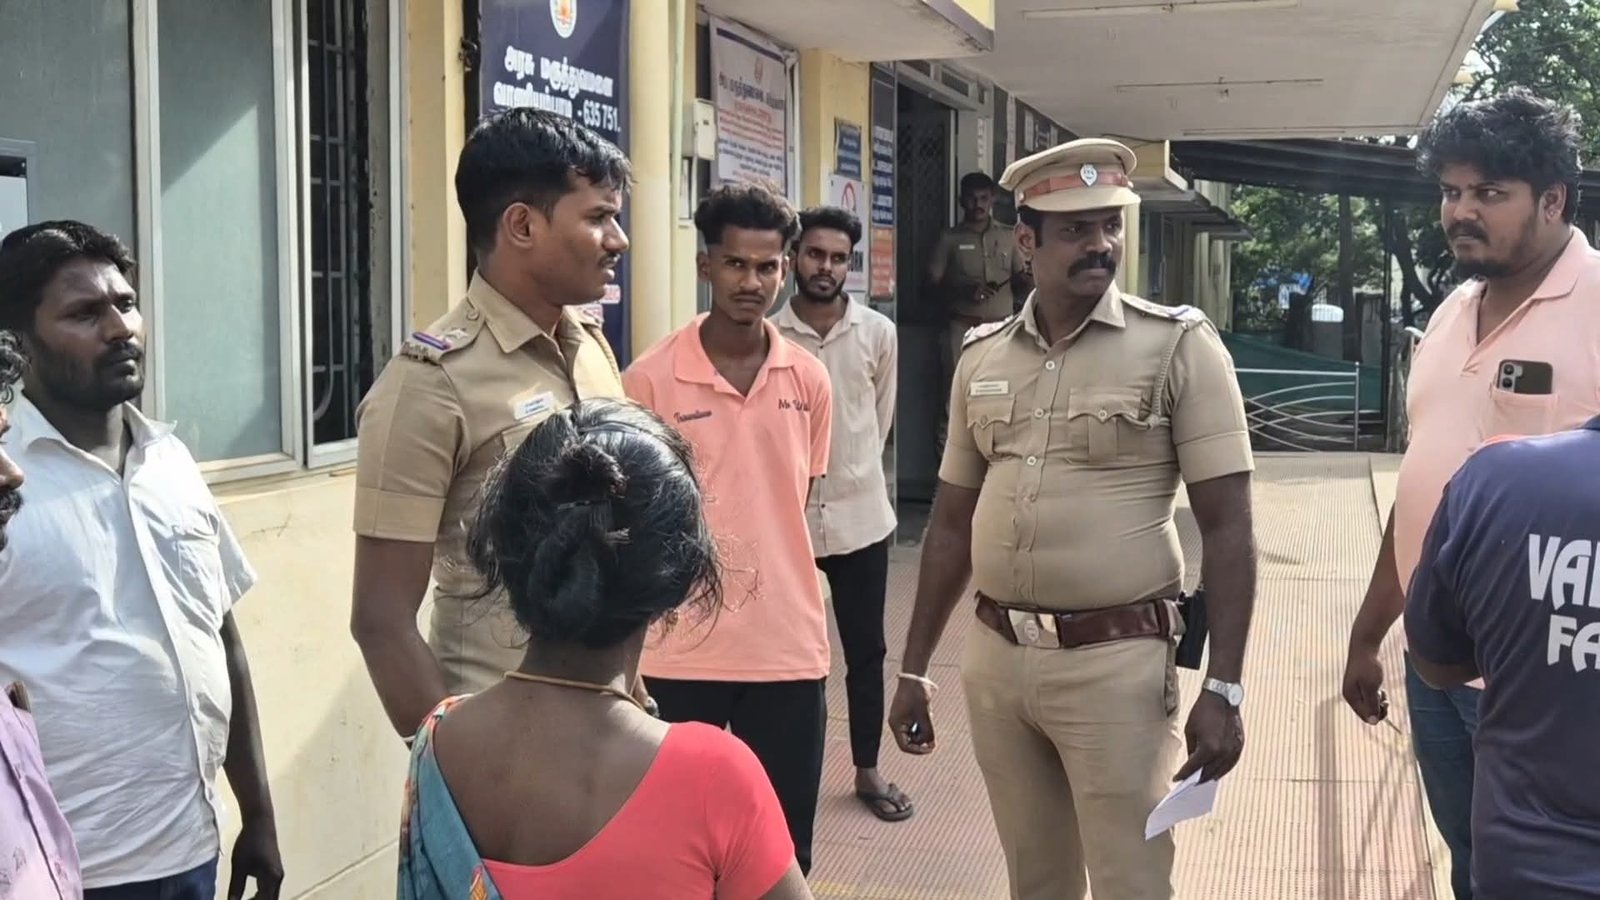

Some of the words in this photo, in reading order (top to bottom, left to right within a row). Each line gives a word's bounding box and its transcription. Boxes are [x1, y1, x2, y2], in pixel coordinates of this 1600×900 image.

[504, 46, 535, 80] அரசு
[540, 56, 614, 99] மருத்துவமனை
[583, 99, 601, 128] 635
